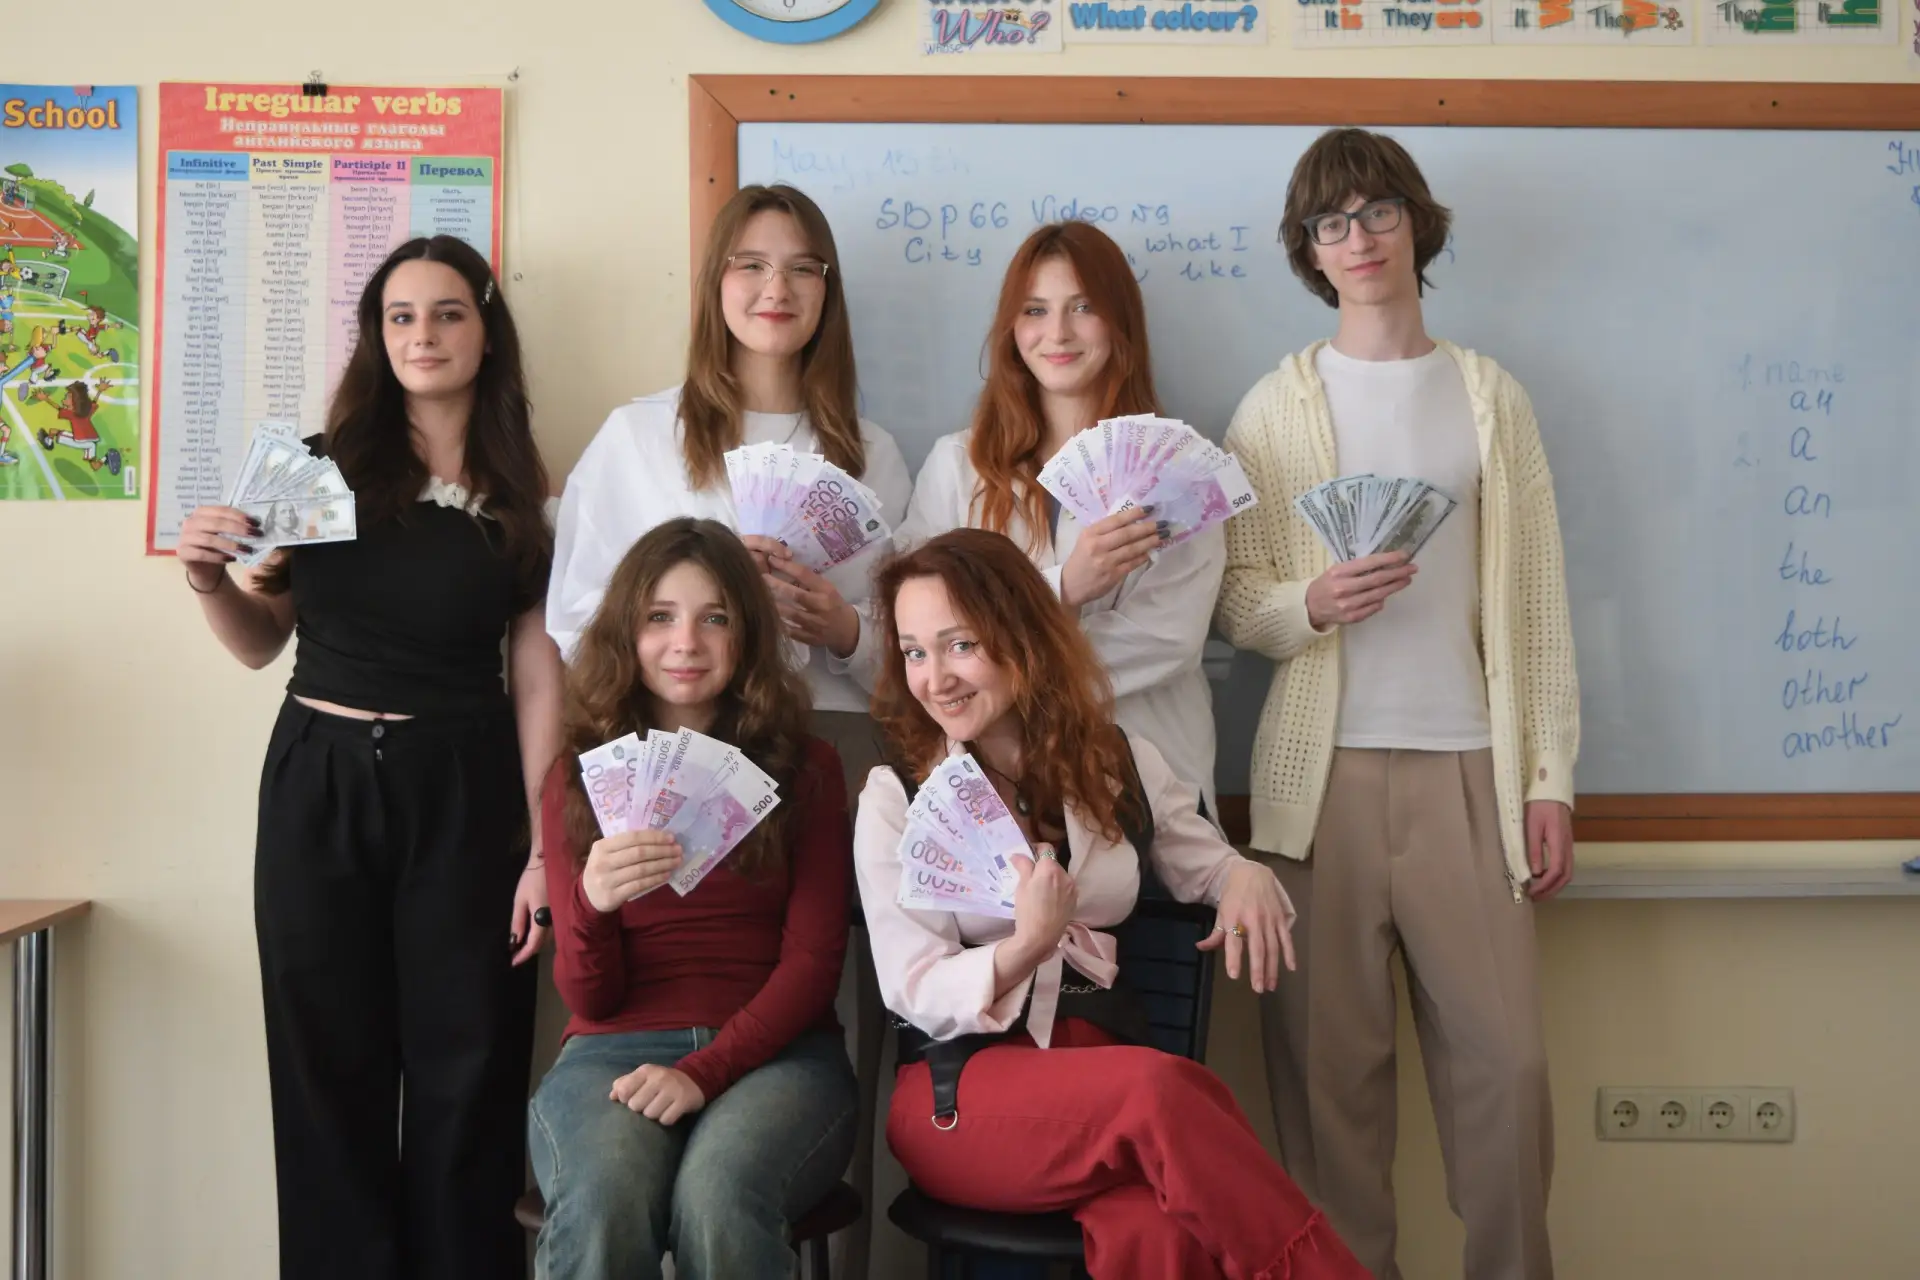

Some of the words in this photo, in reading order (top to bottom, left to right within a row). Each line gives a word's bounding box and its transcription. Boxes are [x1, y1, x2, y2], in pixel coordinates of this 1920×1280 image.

[934, 8, 1051, 45] Who?
[1070, 2, 1147, 31] What
[1152, 3, 1258, 32] colour?
[1324, 9, 1338, 28] It
[1382, 8, 1432, 31] They
[3, 98, 121, 129] School
[205, 86, 360, 117] Irregular
[372, 92, 462, 116] verbs
[220, 117, 360, 135] Неправильные
[367, 122, 446, 136] глаголы
[233, 134, 355, 149] английского
[362, 137, 423, 151] языка
[180, 158, 237, 168] Infinitive
[252, 158, 277, 168] Past
[282, 159, 323, 170] Simple
[334, 159, 391, 171] Participle
[419, 163, 485, 178] Перевод
[1032, 194, 1118, 223] Video
[905, 237, 982, 266] City
[1145, 232, 1221, 254] what
[1230, 226, 1250, 251] I
[1180, 261, 1248, 281] like
[1231, 492, 1252, 509] 500
[1784, 485, 1831, 518] an
[1779, 542, 1832, 585] the
[1775, 610, 1857, 651] both
[1783, 669, 1868, 710] other
[1782, 712, 1902, 758] another
[752, 794, 773, 815] 500
[680, 867, 701, 888] 500
